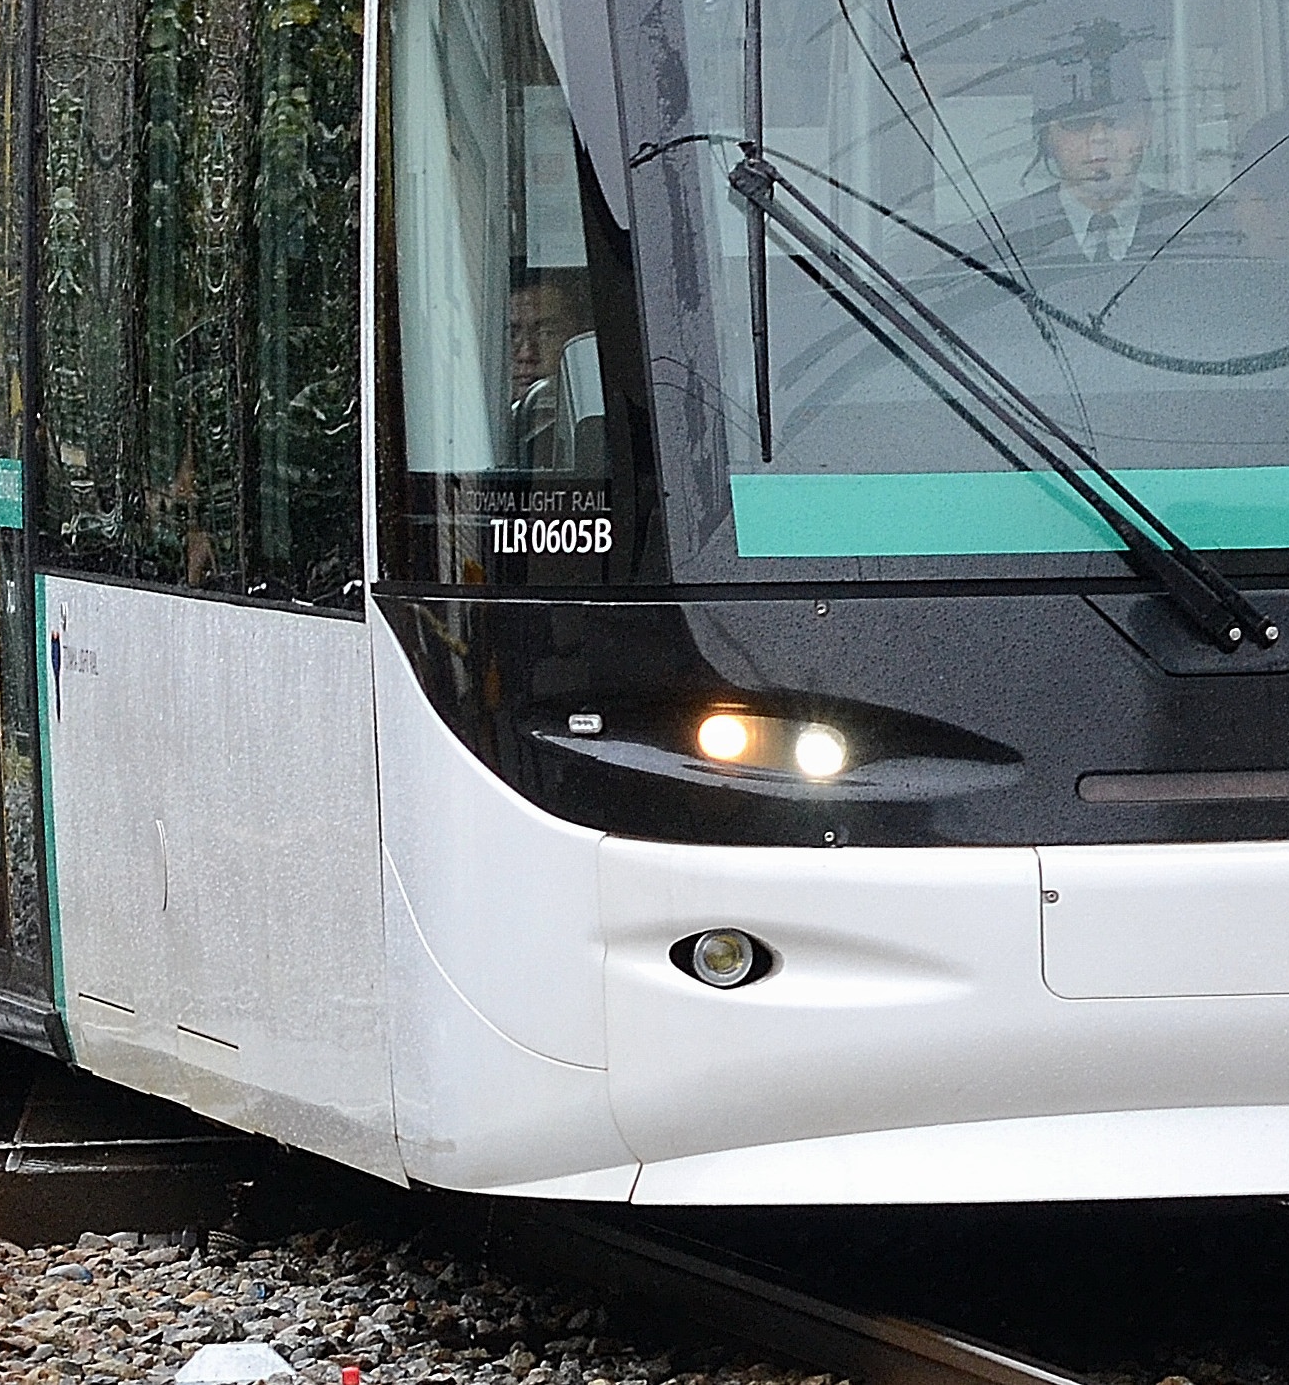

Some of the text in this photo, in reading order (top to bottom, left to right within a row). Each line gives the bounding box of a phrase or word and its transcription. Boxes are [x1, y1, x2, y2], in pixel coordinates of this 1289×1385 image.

[520, 490, 566, 512] LIGHT
[571, 490, 612, 512] RAIL
[489, 517, 613, 554] TLR 0605B
